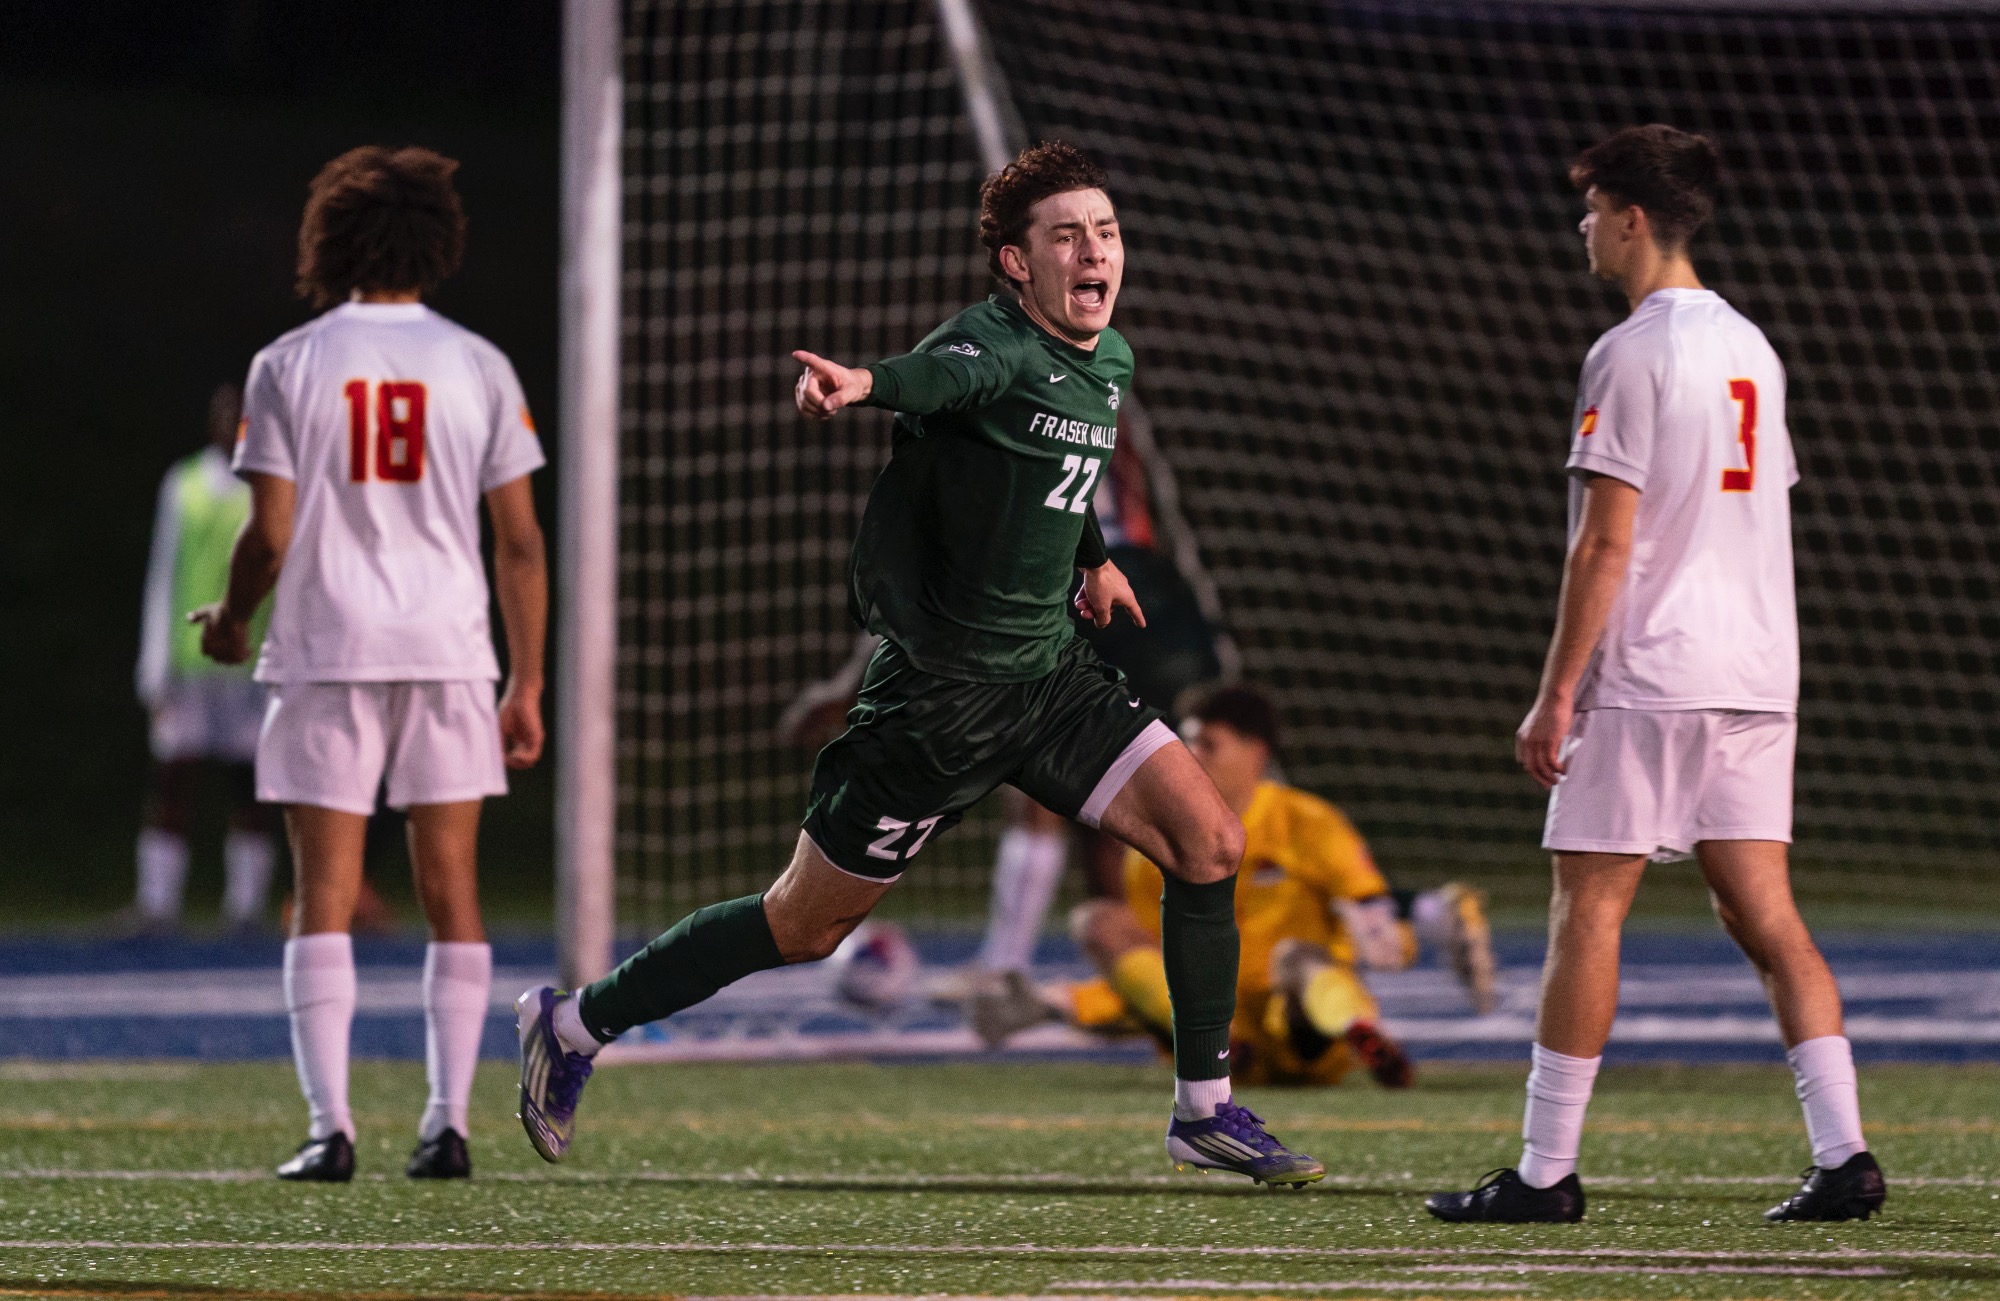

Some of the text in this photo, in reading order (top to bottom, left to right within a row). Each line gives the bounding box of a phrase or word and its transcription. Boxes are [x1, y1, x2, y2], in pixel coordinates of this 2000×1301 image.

[344, 378, 427, 483] 18
[1029, 412, 1090, 445] FRASER
[1720, 377, 1758, 493] 3
[1044, 454, 1101, 514] 22
